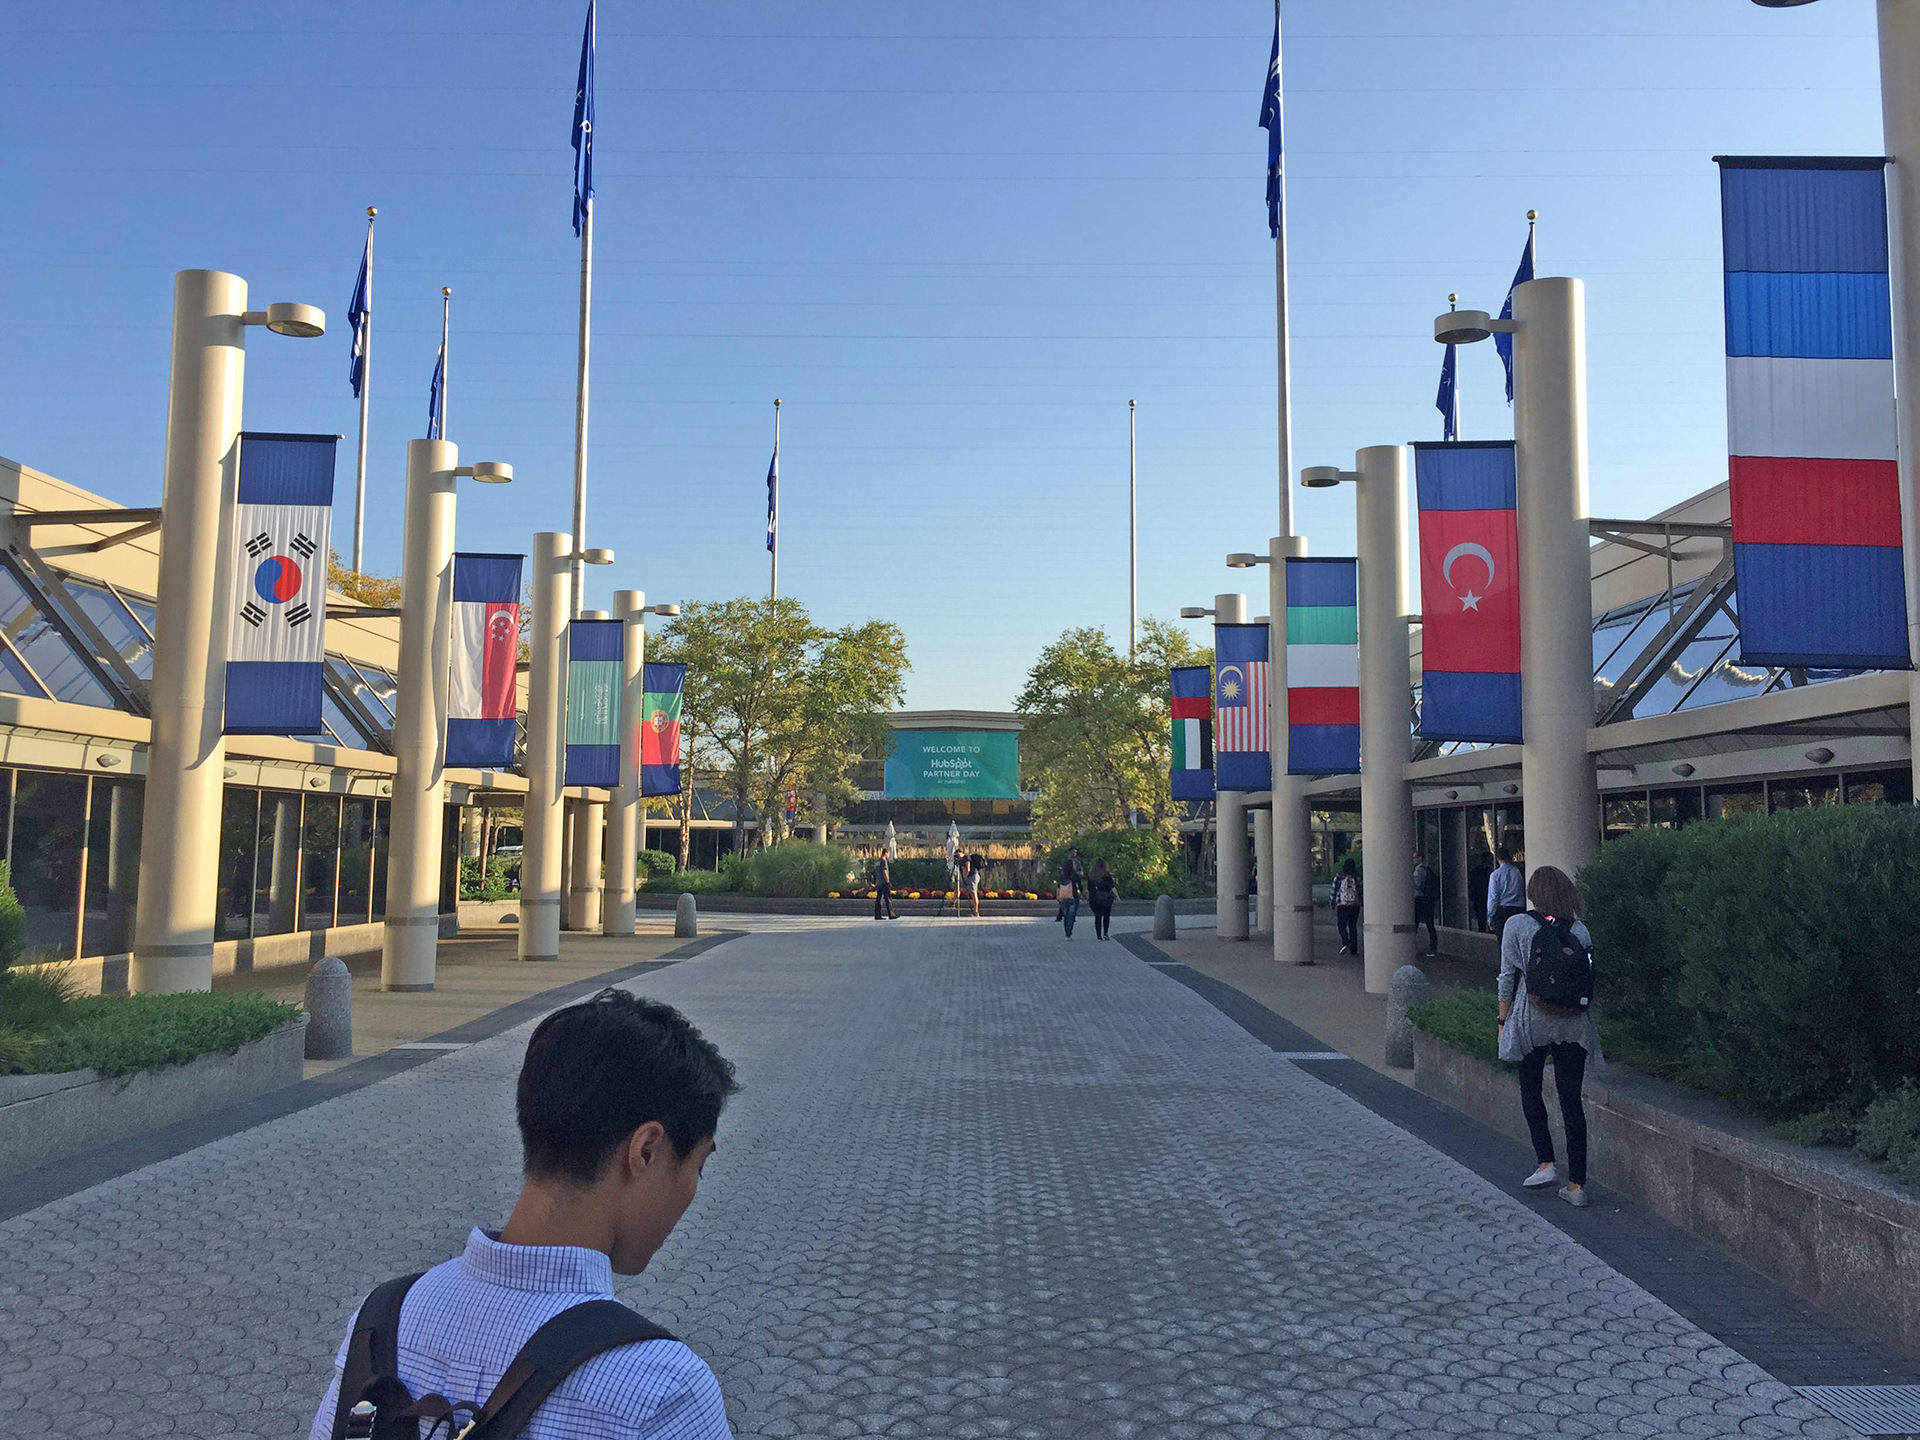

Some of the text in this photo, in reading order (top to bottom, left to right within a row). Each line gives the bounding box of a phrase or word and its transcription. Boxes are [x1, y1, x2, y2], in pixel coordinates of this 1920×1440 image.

[922, 745, 981, 753] WELCOME TO
[931, 757, 972, 769] HubSpot
[923, 770, 980, 778] PARTNER DAY
